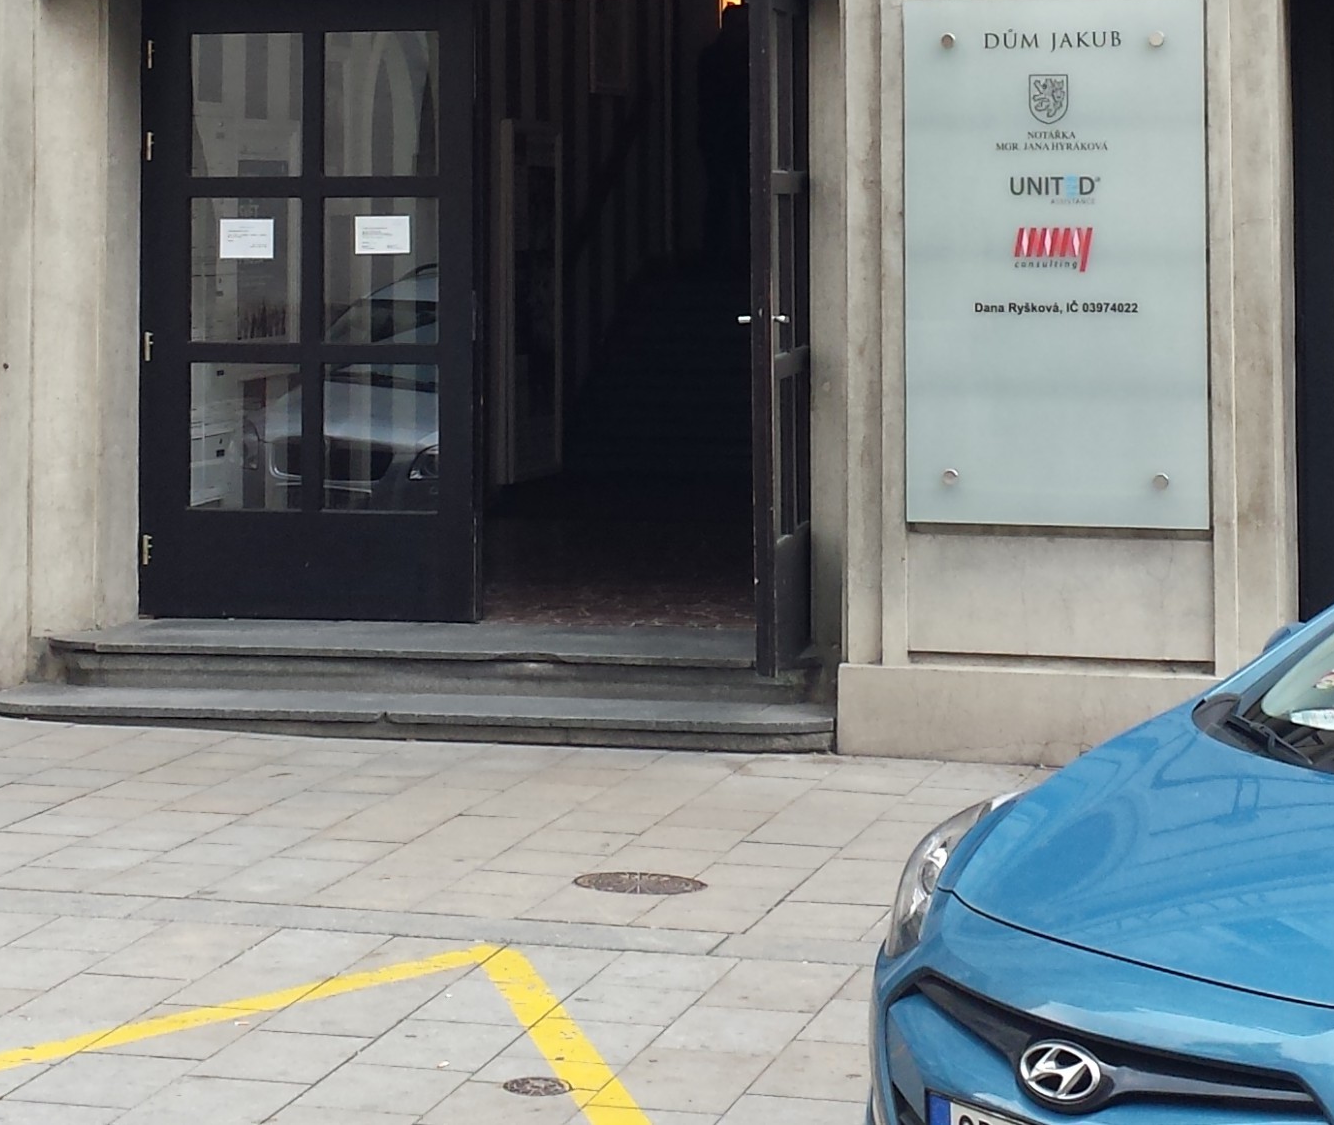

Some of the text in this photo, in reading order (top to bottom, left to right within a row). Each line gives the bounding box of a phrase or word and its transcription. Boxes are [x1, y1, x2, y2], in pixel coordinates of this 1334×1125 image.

[983, 28, 1123, 53] DŮM JAKUB
[1027, 129, 1076, 140] NOTÁŘKA
[1023, 142, 1050, 152] JANA
[1014, 259, 1078, 270] consulting
[974, 300, 1139, 316] Dana Ryšková, IČ 03974022
